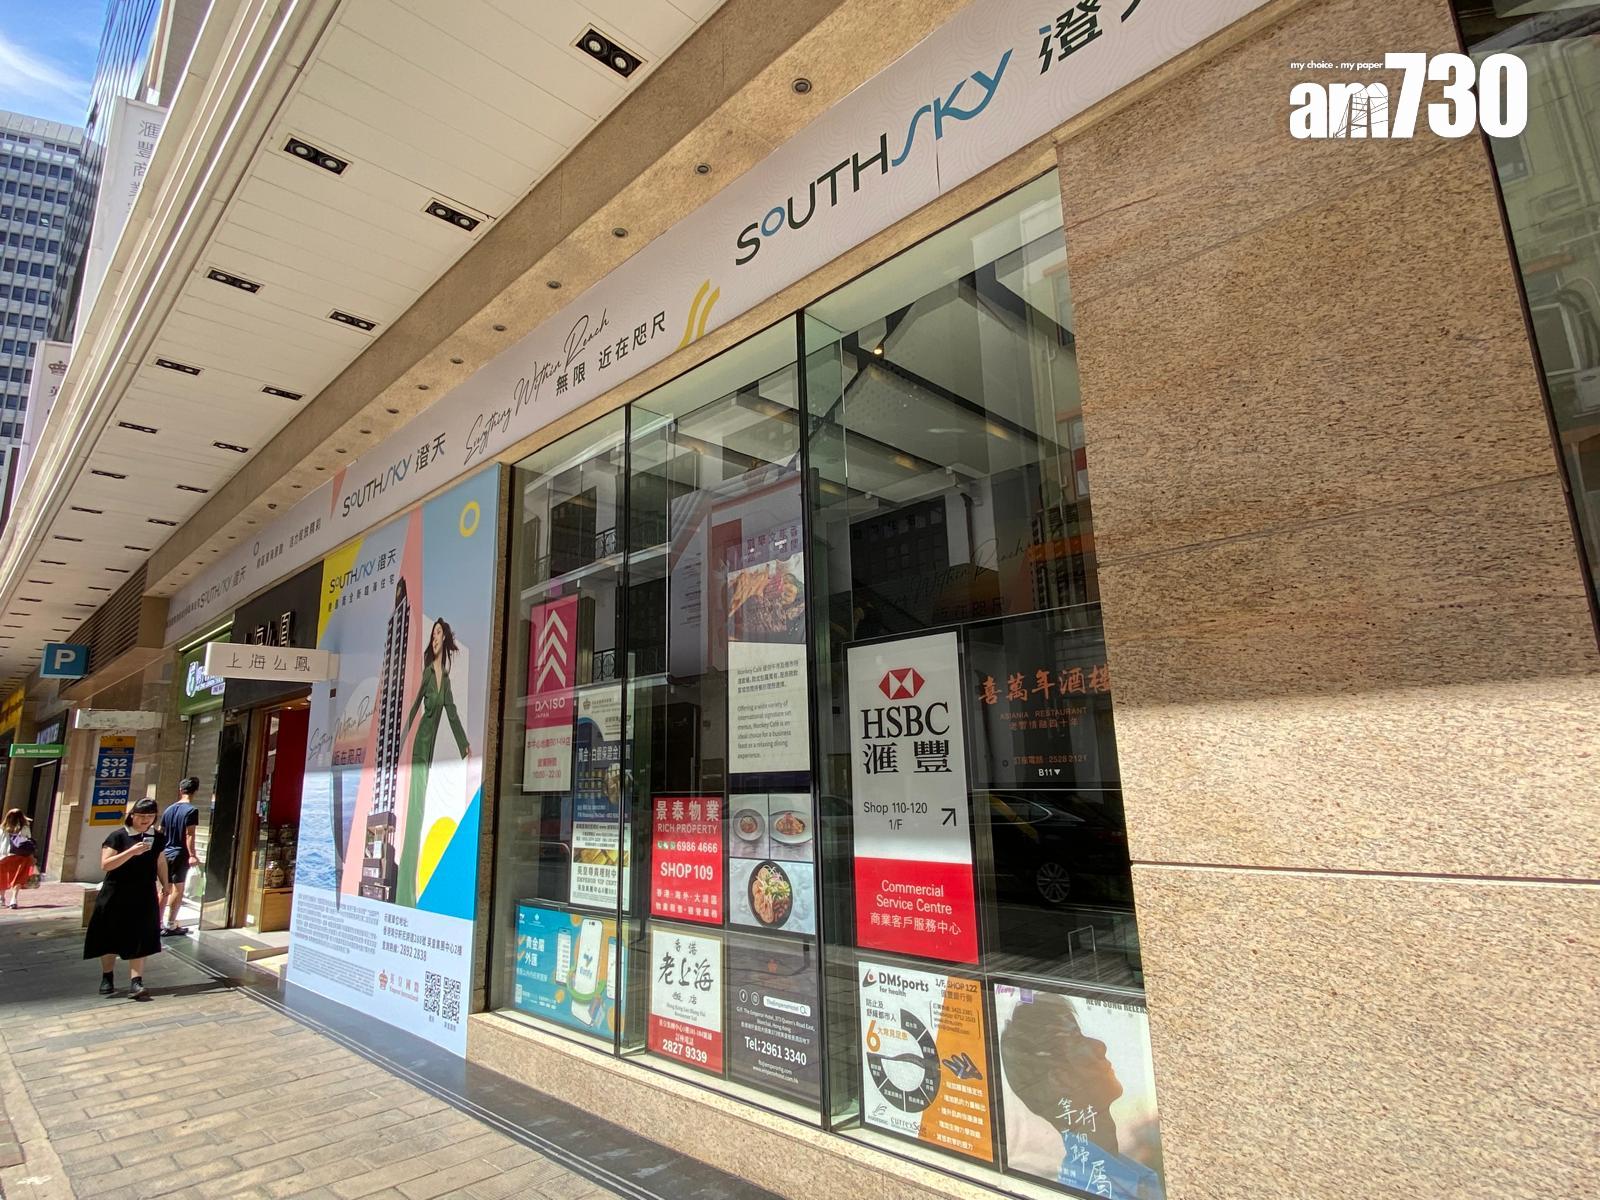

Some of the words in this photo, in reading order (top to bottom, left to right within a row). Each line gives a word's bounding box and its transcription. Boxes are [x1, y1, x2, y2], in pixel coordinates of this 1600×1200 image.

[1039, 0, 1141, 75] 澄
[735, 49, 1013, 266] SOUTHSKY
[556, 362, 586, 397] 無限
[598, 310, 666, 371] 近在咫尺
[415, 432, 446, 473] 澄天
[54, 649, 76, 670] P
[535, 697, 565, 712] DAISO
[861, 702, 950, 739] HSBC
[1038, 768, 1053, 777] B11
[656, 800, 719, 822] 景泰物業
[864, 801, 889, 816] Shop
[891, 802, 928, 815] 110-120
[657, 823, 674, 833] RICH
[676, 824, 718, 835] PROPERTY
[889, 819, 904, 831] 1/F
[676, 840, 696, 852] 6986
[698, 841, 718, 854] 4666
[660, 862, 692, 879] SHOP
[694, 864, 713, 881] 109
[881, 880, 945, 897] Commercial
[876, 895, 914, 911] Service
[916, 898, 953, 915] Centre
[870, 912, 962, 936] 商業客戶服務中心
[658, 952, 714, 992] 老上海
[879, 972, 929, 993] DMSports
[965, 984, 978, 993] 122
[866, 1019, 881, 1052] 6
[662, 1039, 683, 1056] 2827
[685, 1045, 708, 1064] 9339
[784, 1047, 807, 1066] 3340
[1056, 1097, 1098, 1132] 等待
